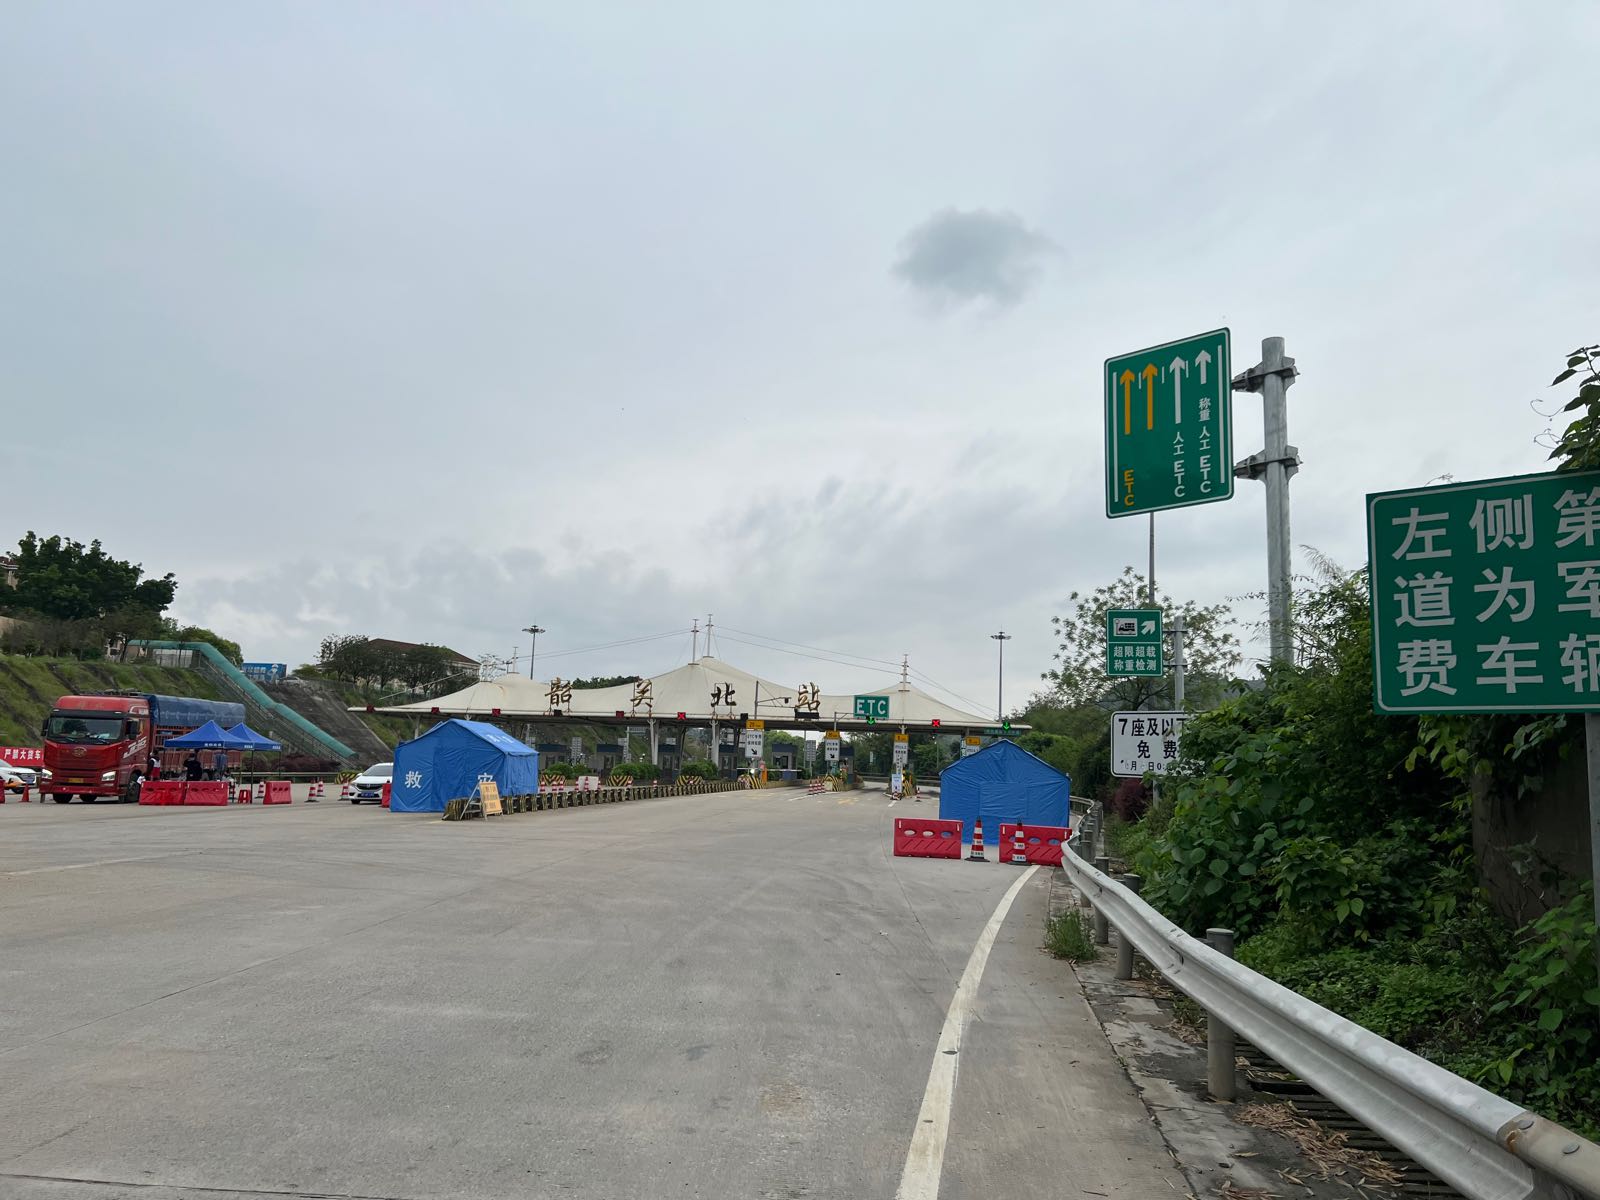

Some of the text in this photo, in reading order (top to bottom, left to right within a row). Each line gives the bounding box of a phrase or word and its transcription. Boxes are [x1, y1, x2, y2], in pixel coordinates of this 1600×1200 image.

[1173, 431, 1184, 455] 人工
[1199, 426, 1210, 450] 人工
[1174, 460, 1185, 497] ETC
[1200, 455, 1211, 493] ETC
[1124, 469, 1134, 506] ETC
[1113, 646, 1156, 657] 超限超载
[1114, 659, 1157, 671] 称重检测
[857, 699, 887, 715] ETC
[1137, 740, 1177, 759] 免费
